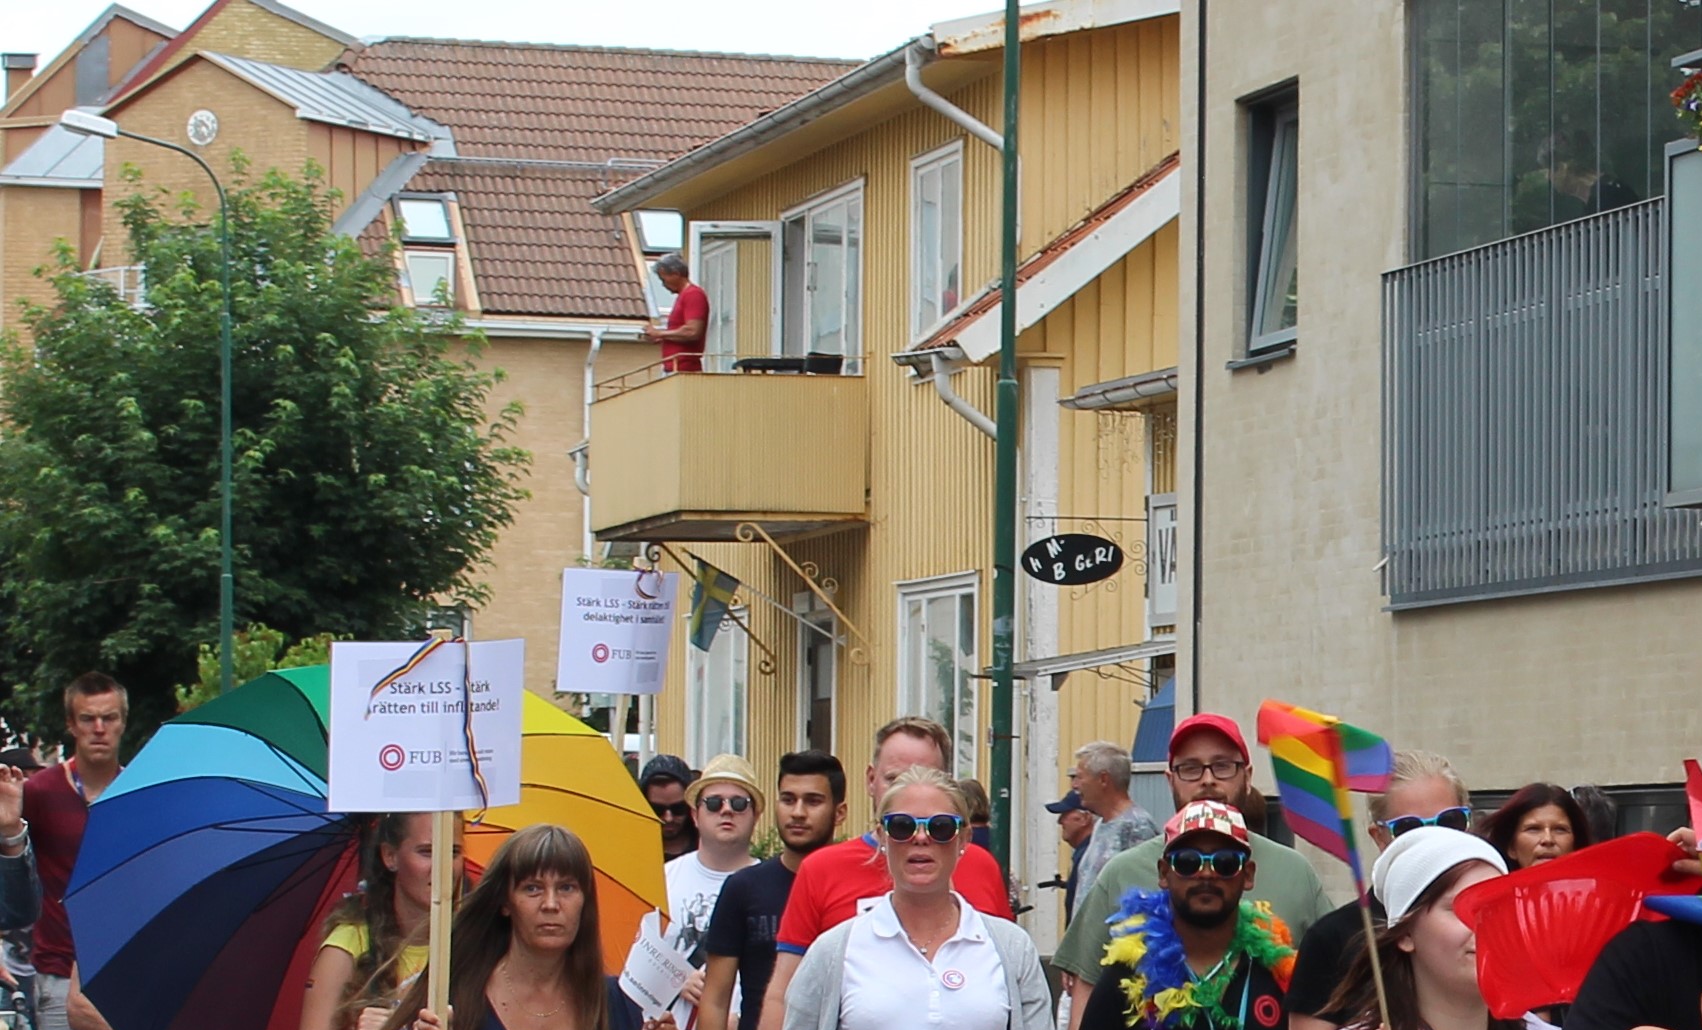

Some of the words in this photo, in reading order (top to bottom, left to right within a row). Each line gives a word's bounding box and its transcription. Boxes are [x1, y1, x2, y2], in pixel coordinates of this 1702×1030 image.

[576, 597, 601, 606] Stärk
[604, 599, 620, 608] LSS
[583, 612, 634, 624] delaktighet
[611, 649, 632, 660] FUB
[390, 681, 425, 694] Stärk
[430, 682, 451, 694] LSS
[470, 680, 491, 693] tärk
[372, 699, 416, 714] rätten
[420, 700, 439, 714] till
[443, 698, 500, 714] infltande!
[408, 750, 442, 765] FUB
